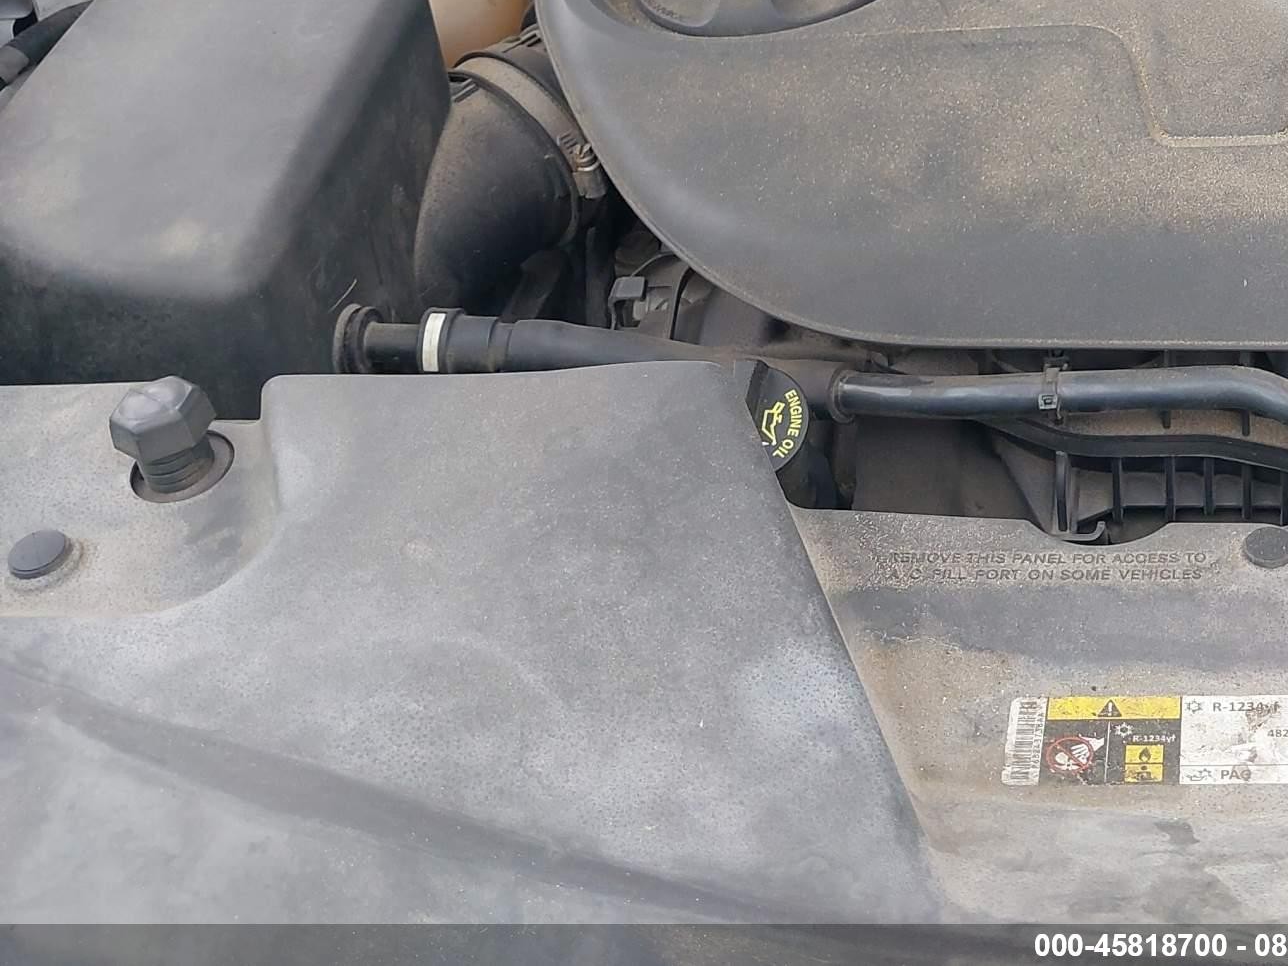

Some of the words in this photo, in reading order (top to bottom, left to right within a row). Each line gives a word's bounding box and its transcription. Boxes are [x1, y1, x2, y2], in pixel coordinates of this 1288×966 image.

[784, 389, 803, 437] ENGINE
[772, 439, 794, 458] OIL
[966, 552, 1006, 563] THIS
[1012, 552, 1067, 564] PANEL
[1072, 552, 1106, 564] FOR
[1111, 552, 1180, 564] ACCESS
[1186, 552, 1207, 564] TO
[932, 568, 967, 580] FILL
[1028, 568, 1054, 580] ON
[1059, 569, 1111, 580] SOME
[1119, 569, 1202, 580] VEHICLES
